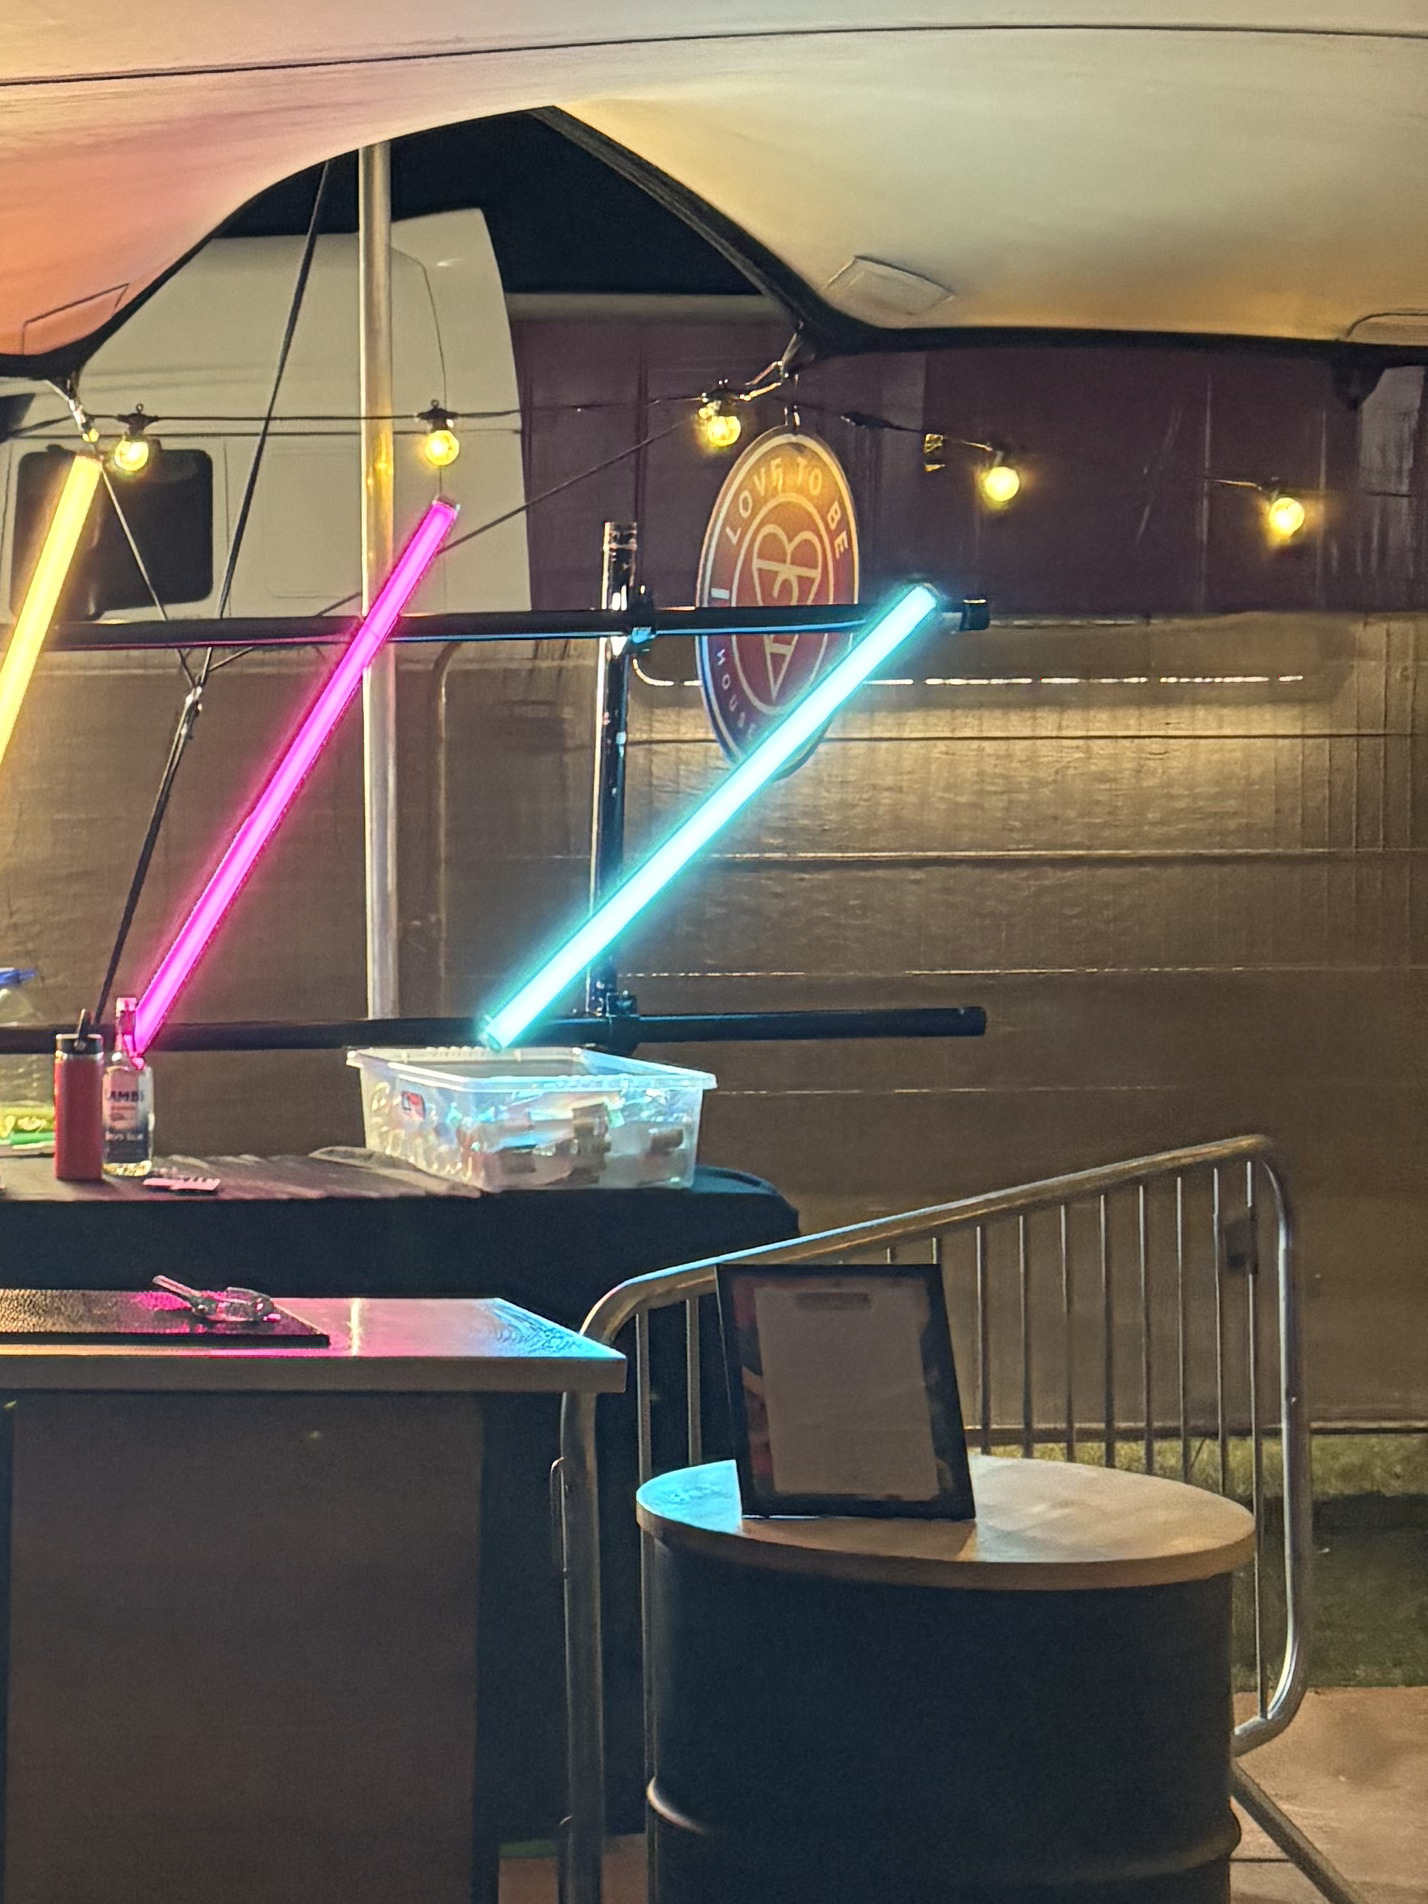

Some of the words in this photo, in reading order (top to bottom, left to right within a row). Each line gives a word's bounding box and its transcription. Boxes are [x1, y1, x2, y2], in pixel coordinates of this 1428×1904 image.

[725, 457, 784, 546] LOVE
[796, 456, 823, 496] TO
[826, 500, 849, 559] BE
